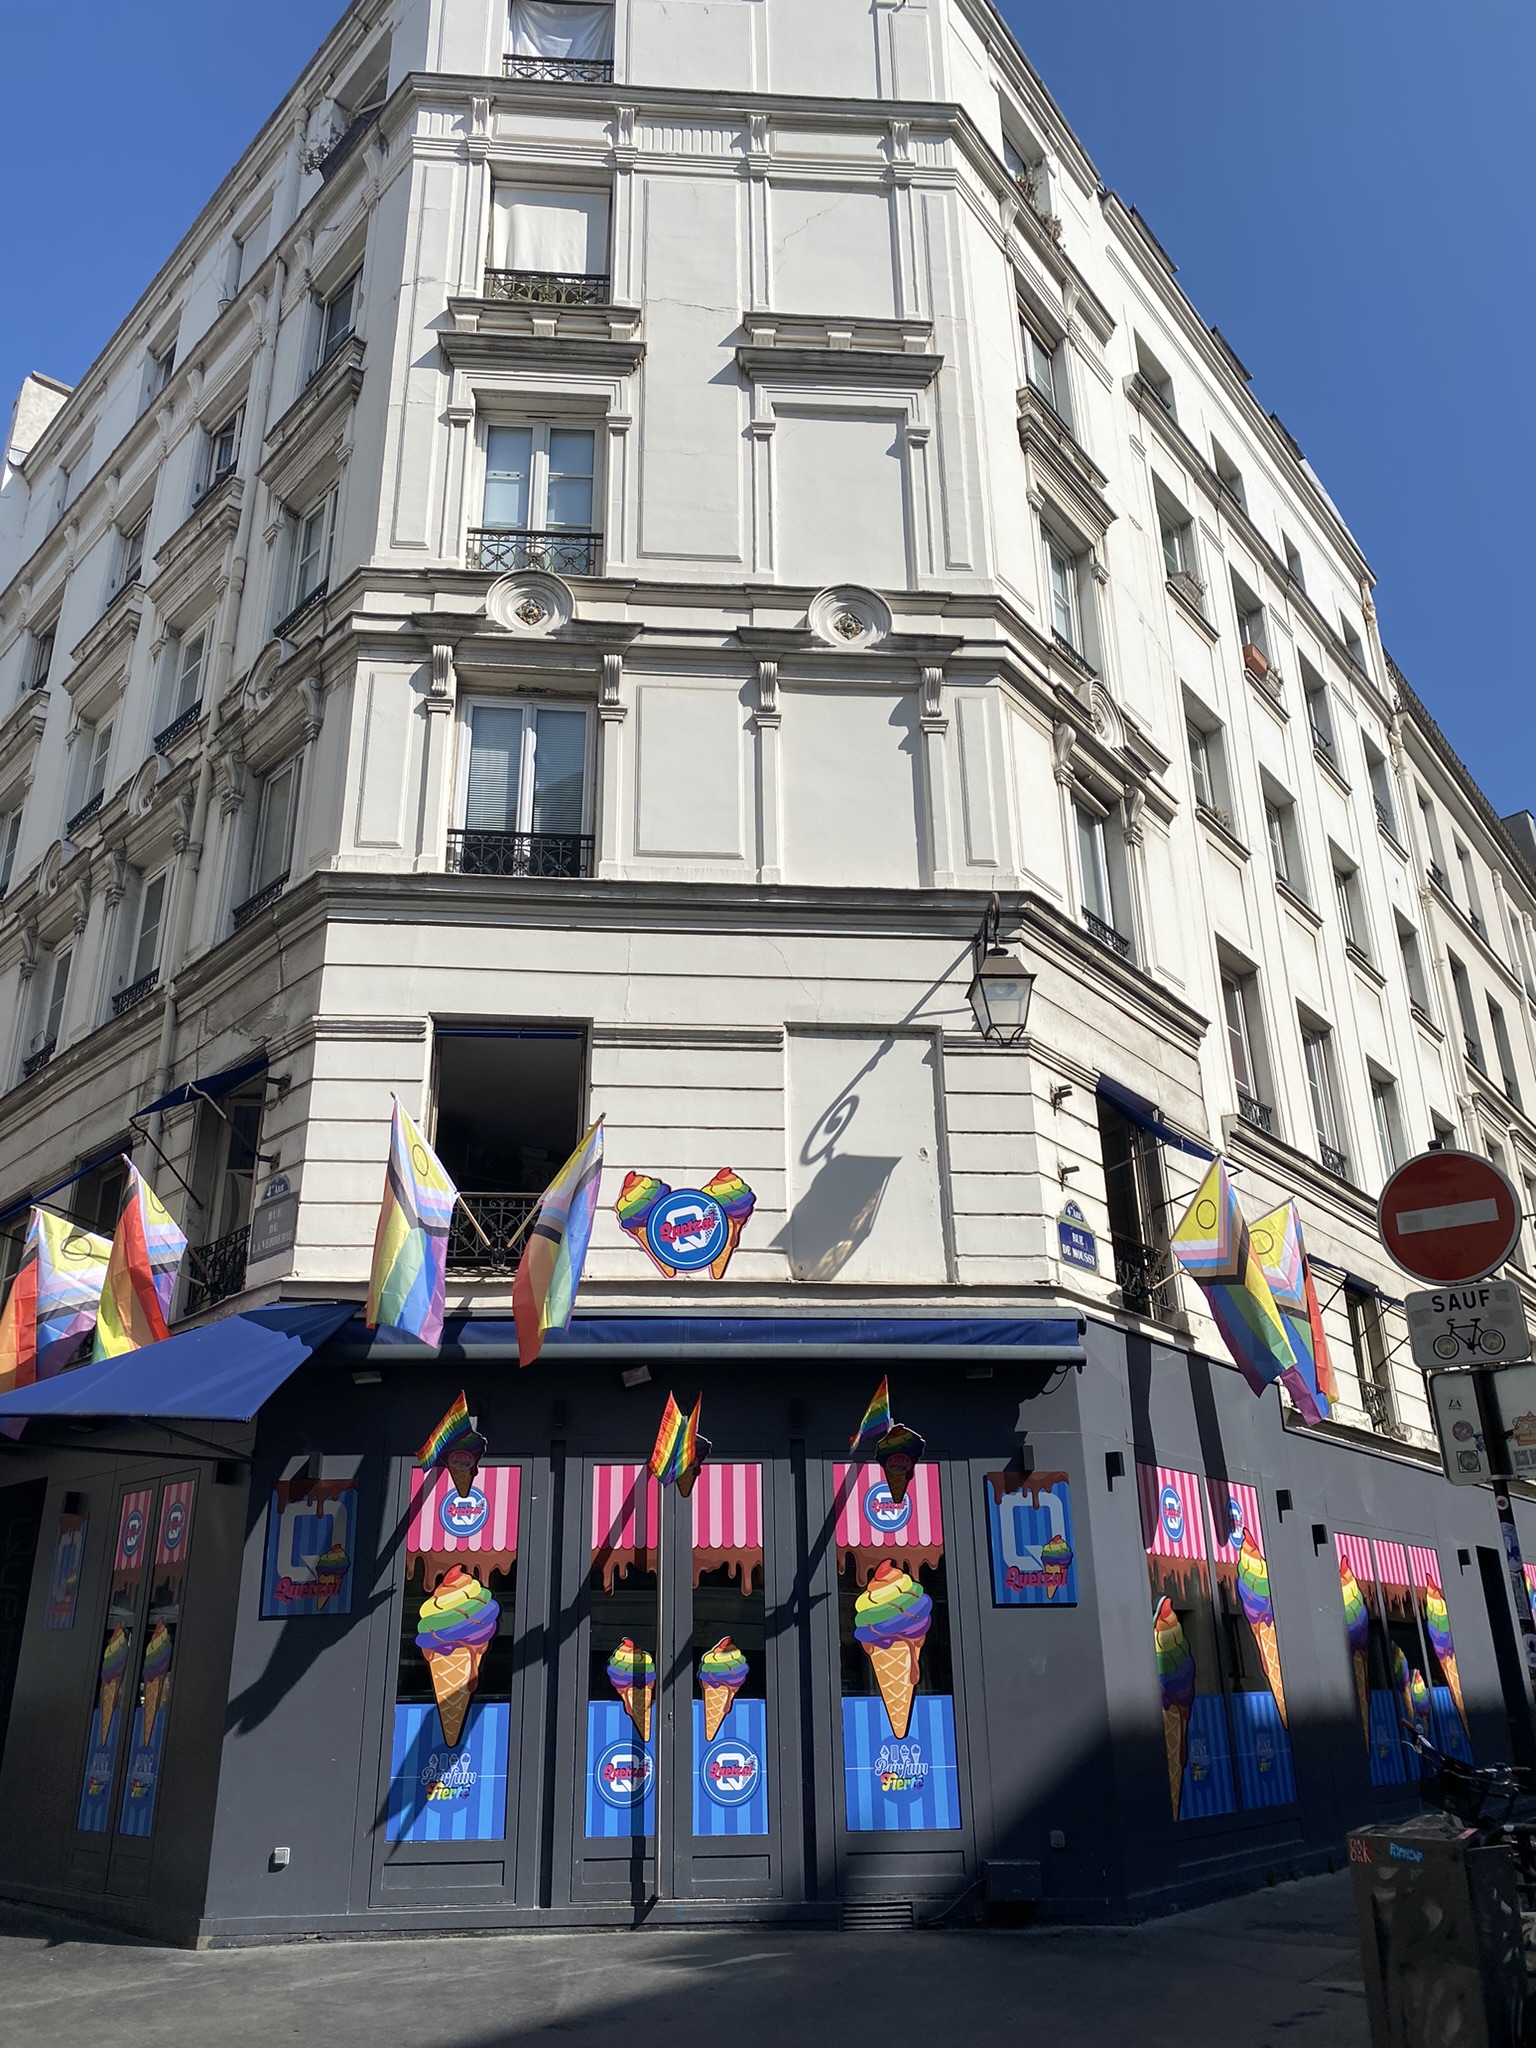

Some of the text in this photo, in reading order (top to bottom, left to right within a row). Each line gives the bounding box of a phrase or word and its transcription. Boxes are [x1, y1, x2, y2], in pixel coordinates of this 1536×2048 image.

[268, 1208, 282, 1221] RUE
[269, 1222, 279, 1234] DE
[660, 1212, 715, 1244] Quetzal
[253, 1230, 292, 1252] LA VERRERIE
[1432, 1288, 1490, 1313] SAUF
[275, 1577, 342, 1603] Quetzal
[1006, 1566, 1067, 1592] Quetzal
[421, 1766, 477, 1787] Parfum
[874, 1757, 929, 1778] Parfum
